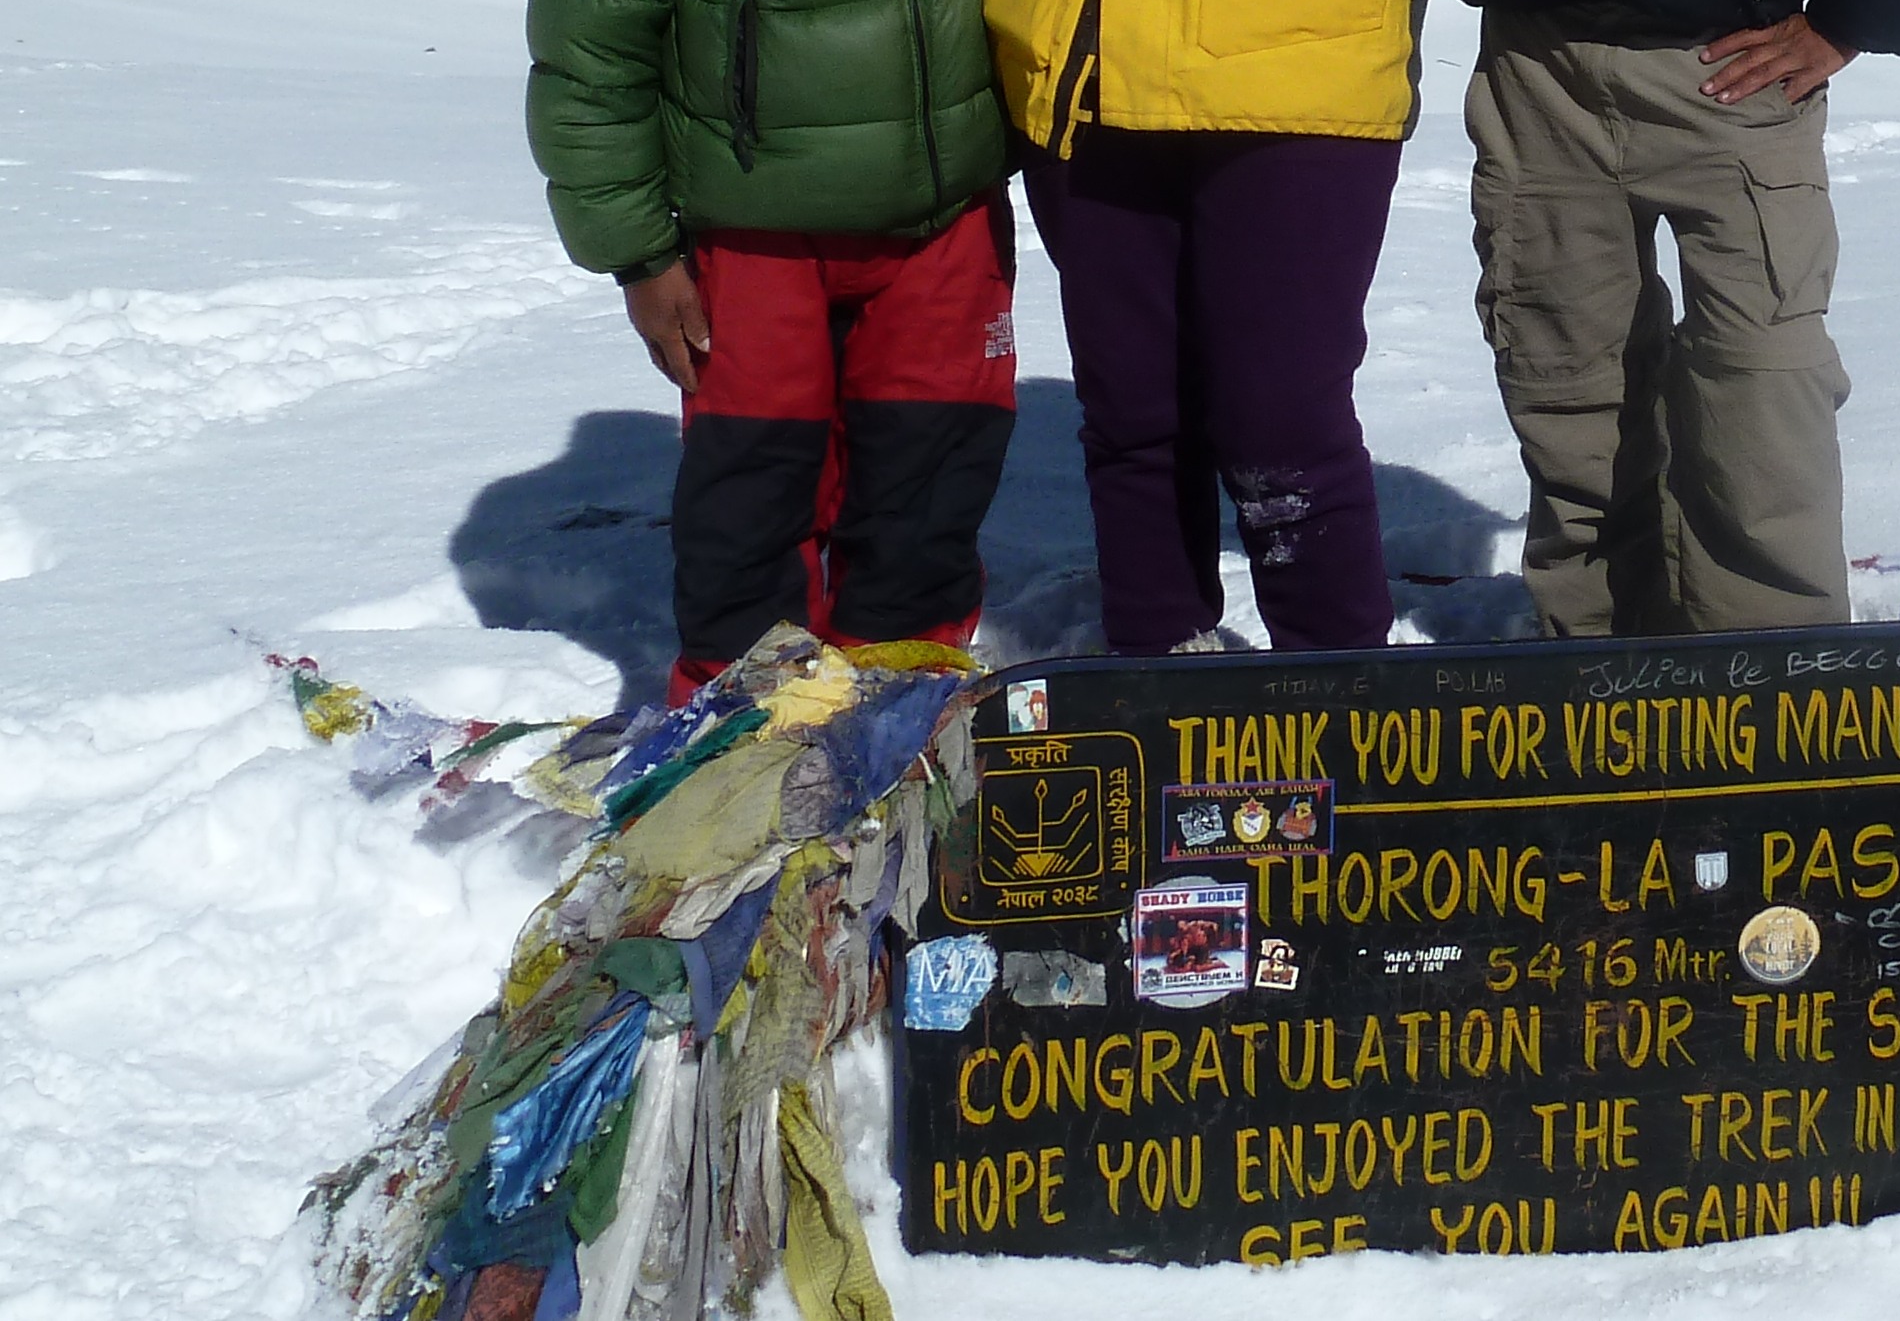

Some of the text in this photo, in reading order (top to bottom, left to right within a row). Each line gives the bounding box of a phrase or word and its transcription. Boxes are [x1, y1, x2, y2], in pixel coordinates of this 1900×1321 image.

[1006, 740, 1072, 768] प्रकृति
[1169, 711, 1328, 785] THANK
[1350, 708, 1440, 785] YOU
[1461, 704, 1547, 779] FOR
[1564, 693, 1756, 777] VISITING
[996, 887, 1046, 909] नेपाल
[1141, 890, 1244, 906] SHADY HORSE
[1247, 838, 1675, 926] THORONG-LA
[1485, 936, 1638, 993] 5416
[959, 1005, 1542, 1124] CONGRATULATION
[1584, 996, 1695, 1071] FOR
[1732, 990, 1836, 1062] THE
[934, 1146, 1067, 1234] HOPE
[1098, 1134, 1201, 1215] YOU
[1236, 1108, 1492, 1204] ENJOYED
[1531, 1098, 1640, 1171] THE
[1682, 1088, 1829, 1162] TREK
[1855, 1082, 1896, 1153] IN
[1240, 1215, 1368, 1268] SEE
[1430, 1197, 1556, 1255] YOU
[1614, 1180, 1789, 1252] AGAIN
